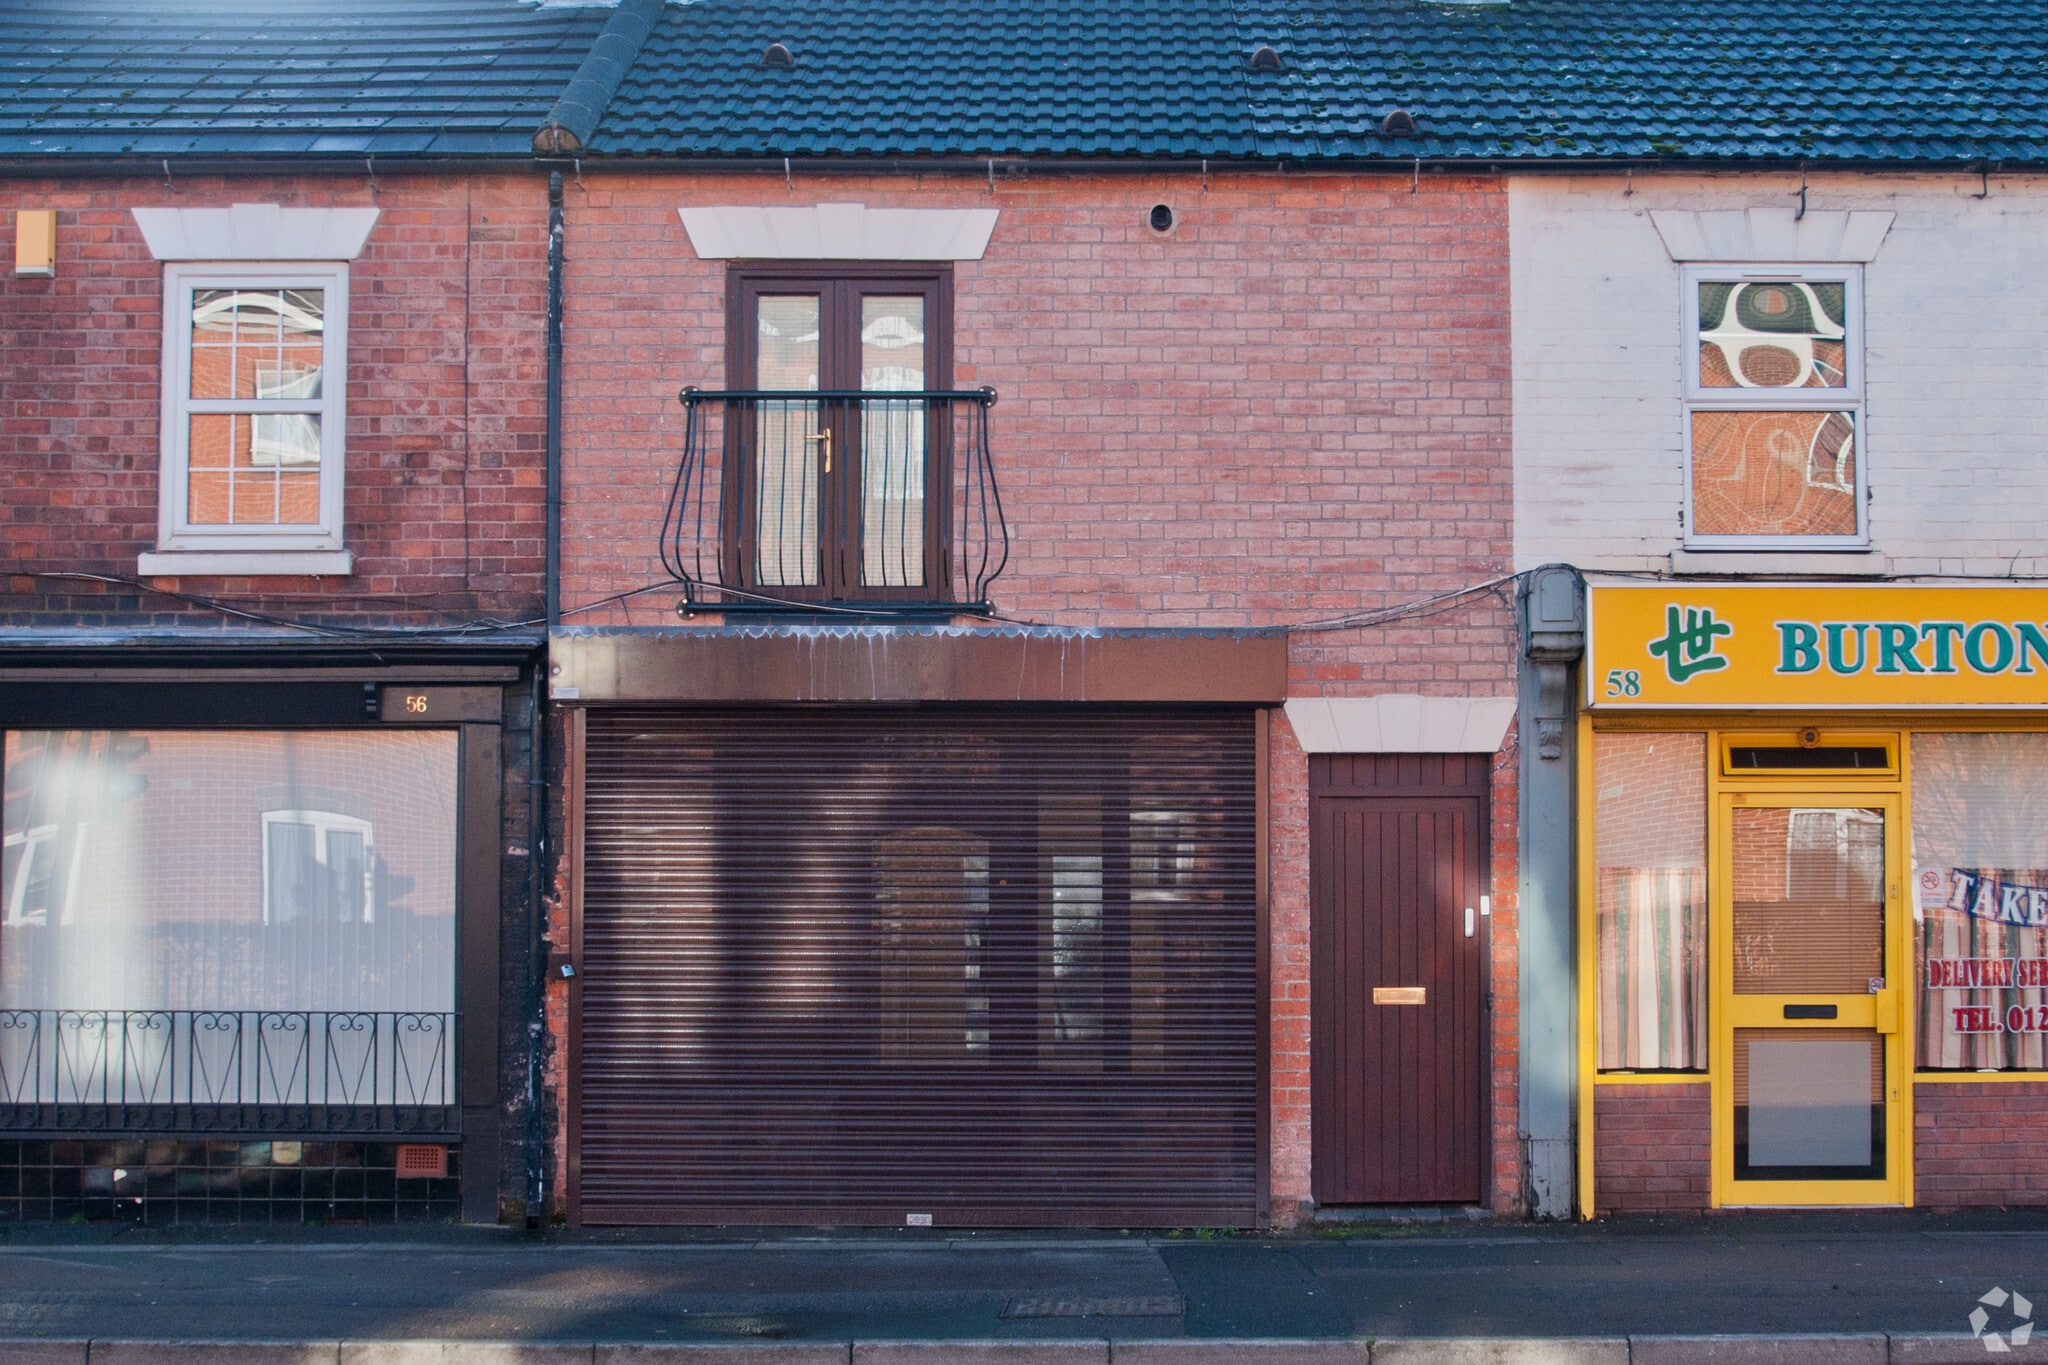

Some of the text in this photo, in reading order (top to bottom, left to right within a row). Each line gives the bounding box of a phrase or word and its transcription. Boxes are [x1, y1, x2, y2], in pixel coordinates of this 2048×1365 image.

[1776, 621, 2048, 674] BURTON
[1606, 670, 1641, 697] 58
[406, 696, 427, 712] 56
[1950, 869, 2048, 926] TAKE
[1928, 959, 2014, 988] DELIVERY
[1952, 1006, 2048, 1032] TEL. 012
